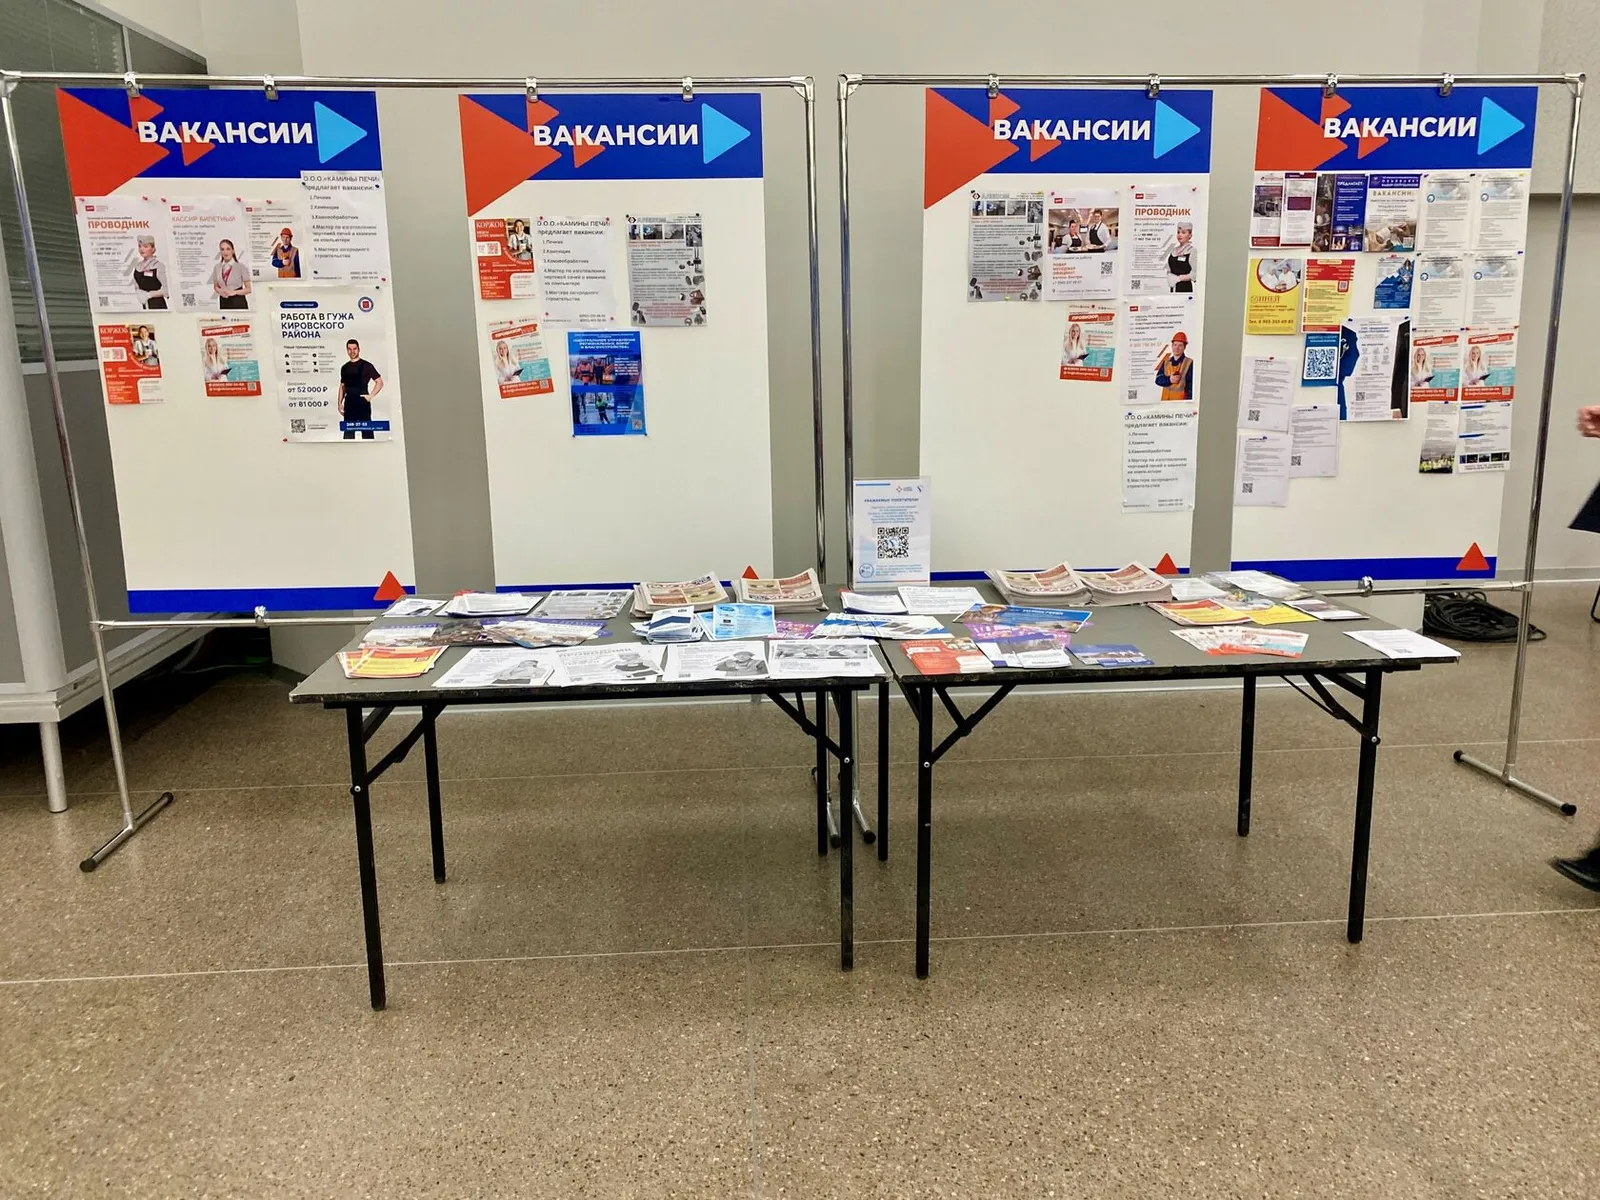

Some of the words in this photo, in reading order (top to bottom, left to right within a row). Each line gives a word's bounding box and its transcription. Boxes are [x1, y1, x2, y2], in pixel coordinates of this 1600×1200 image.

[137, 120, 313, 144] ВАКАНСИИ
[533, 124, 699, 146] ВАКАНСИИ
[993, 120, 1152, 141] ВАКАНСИИ
[1323, 116, 1478, 138] ВАКАНСИИ
[1134, 208, 1191, 217] ПРОВОДНИК
[88, 220, 150, 230] ПРОВОДНИК
[282, 330, 321, 338] РАЙОНА
